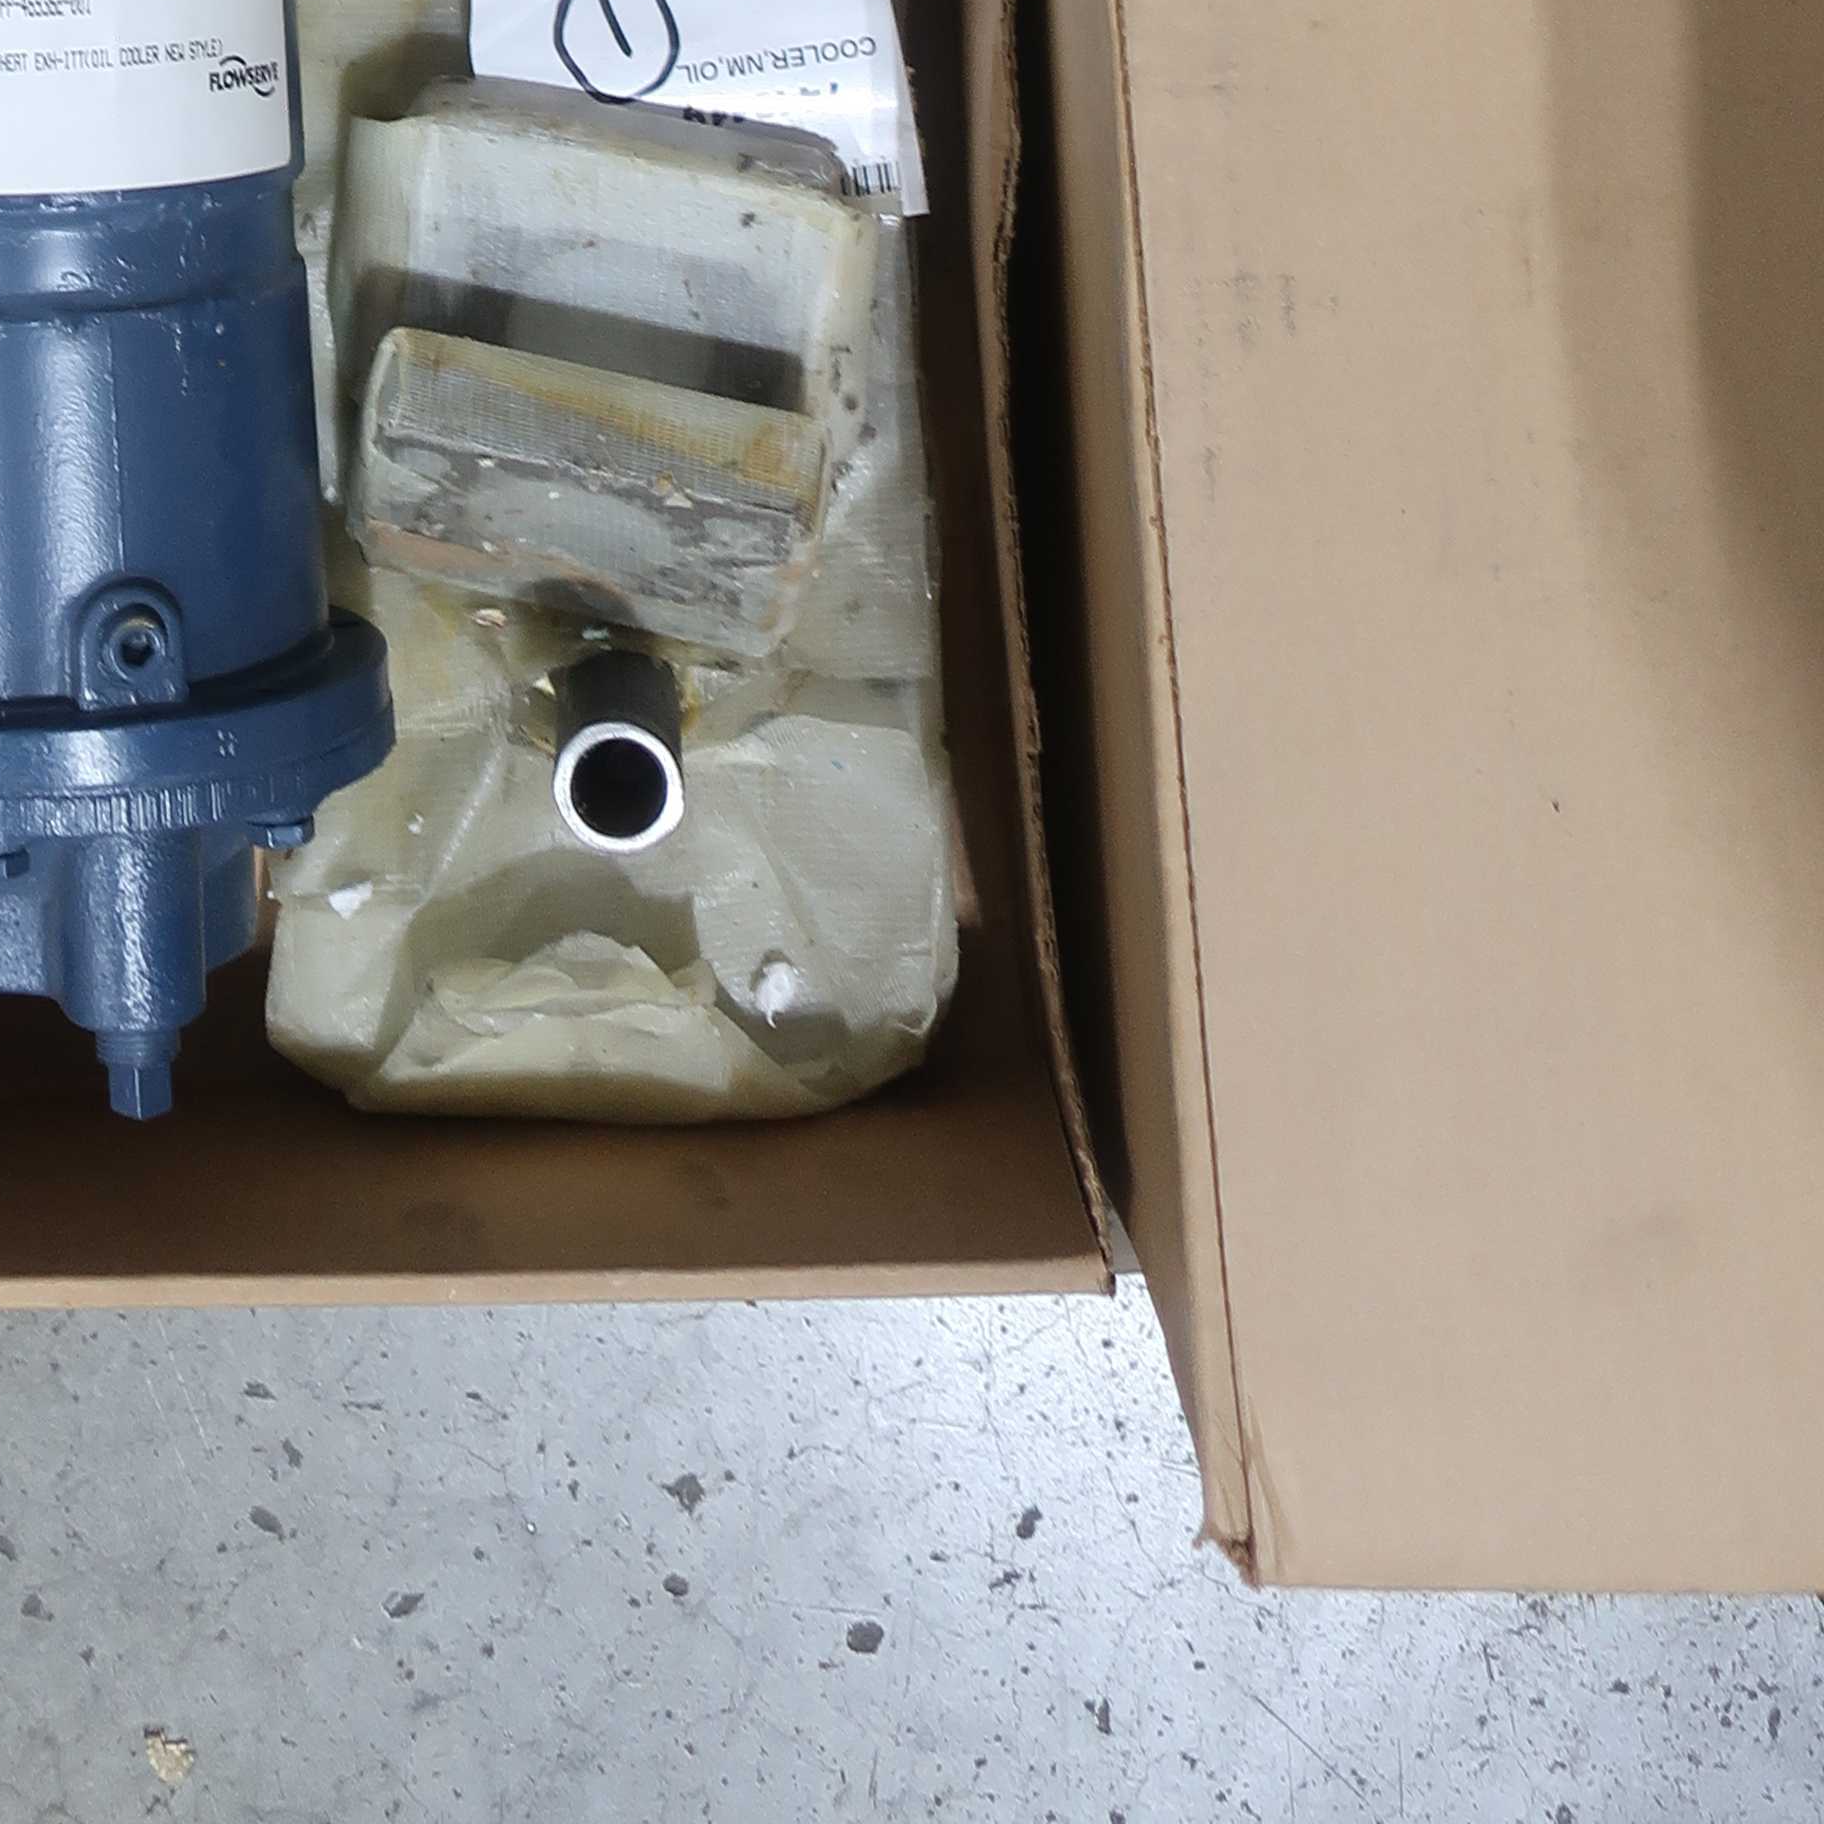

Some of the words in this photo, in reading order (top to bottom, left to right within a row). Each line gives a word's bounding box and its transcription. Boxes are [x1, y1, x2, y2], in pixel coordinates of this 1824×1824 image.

[119, 43, 159, 68] COOLER
[208, 55, 280, 97] FLOWSERVE
[675, 35, 877, 83] COOLER,NM,OIL
